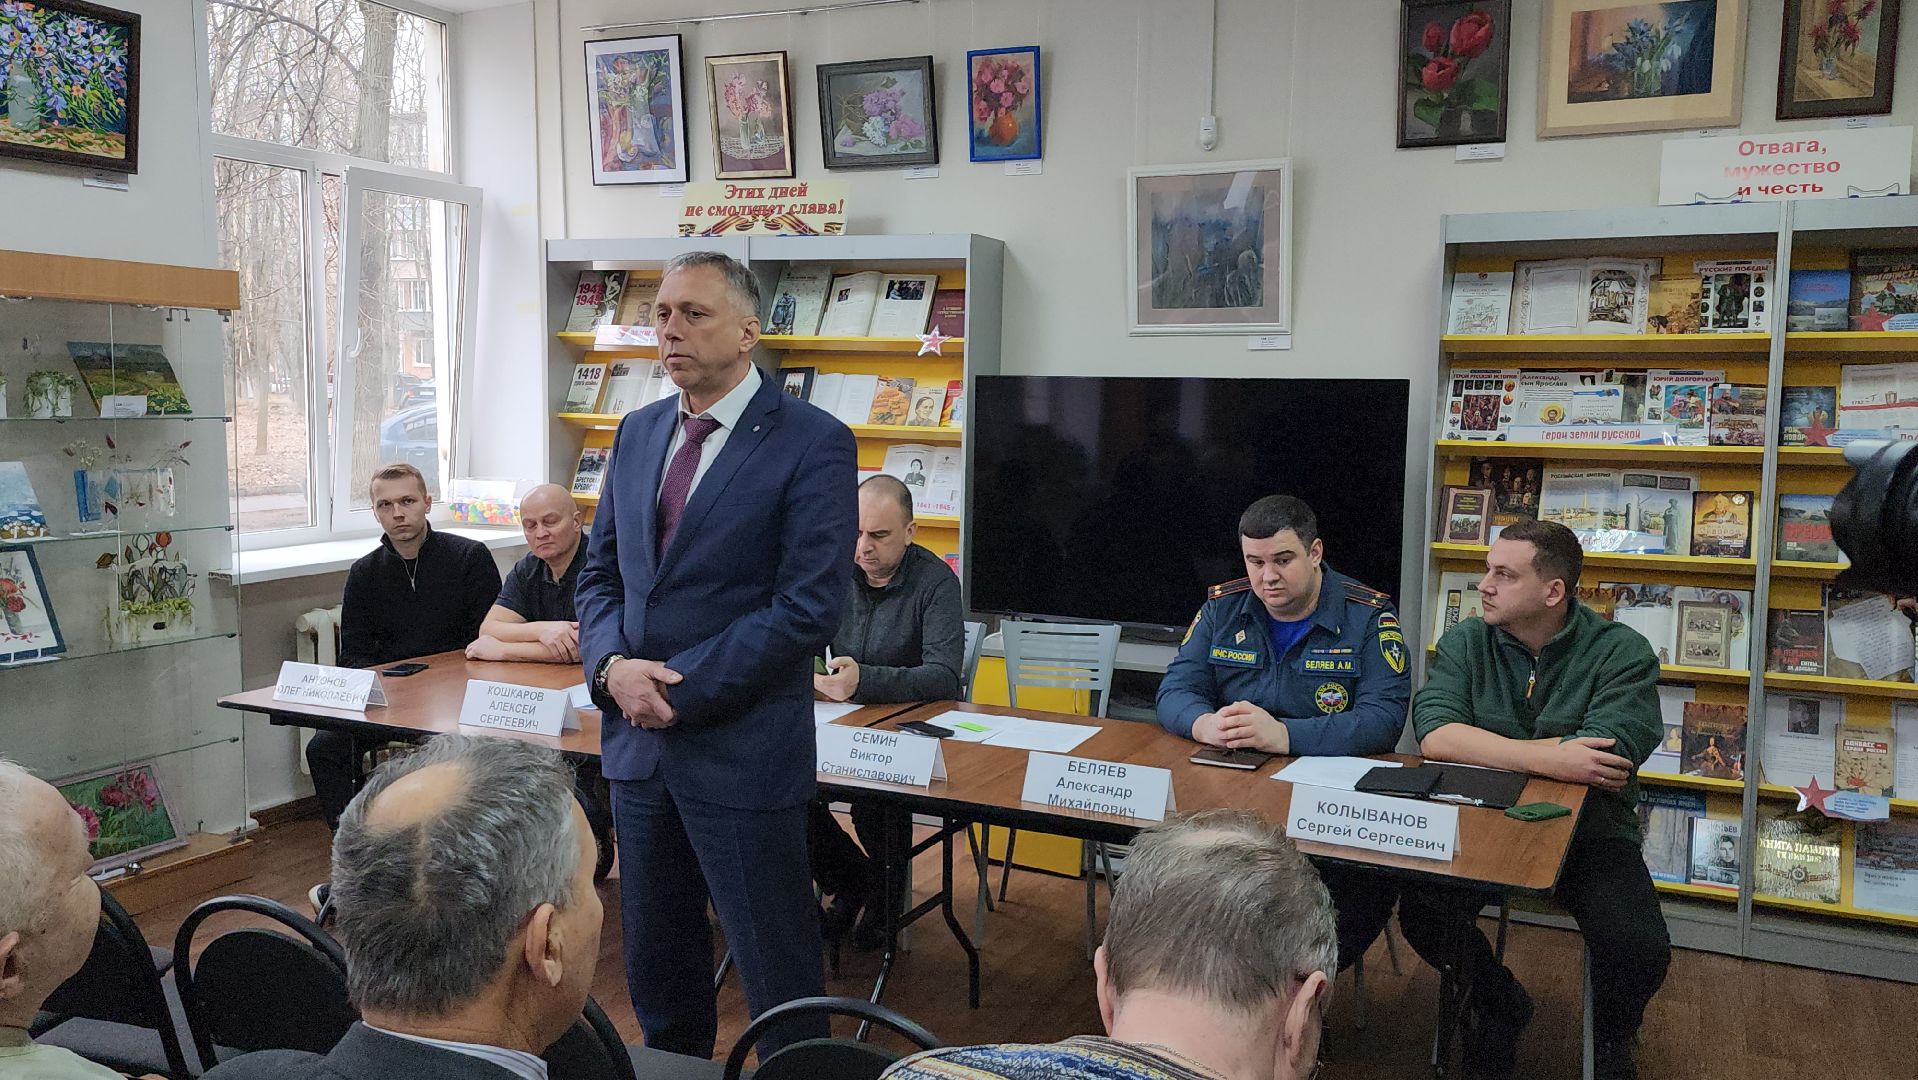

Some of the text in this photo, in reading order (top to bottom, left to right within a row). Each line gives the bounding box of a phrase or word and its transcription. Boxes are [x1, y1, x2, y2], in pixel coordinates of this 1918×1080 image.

[1738, 140, 1827, 156] Отвага,
[1724, 161, 1840, 180] мужество
[724, 182, 808, 201] Этих дней
[1738, 183, 1824, 196] и честь
[685, 199, 844, 218] не смолкнет слава!
[577, 367, 602, 380] 1418
[1541, 429, 1641, 441] Герои земли русской
[1228, 650, 1256, 662] РОССИИ
[1305, 660, 1334, 670] БЕЛЯЕВ
[278, 684, 302, 695] ОЛЕГ
[301, 674, 348, 688] АНТОНОВ
[487, 684, 545, 702] КОШКАРОВ
[488, 701, 537, 717] АЛЕКСЕЙ
[479, 713, 540, 730] СЕРГЕЕВИЧ
[852, 731, 899, 749] СЕМИН
[849, 748, 893, 766] Виктор
[820, 761, 917, 787] Станиславович
[1067, 760, 1127, 779] БЕЛЯЕВ
[1056, 776, 1134, 800] Александр
[1047, 793, 1138, 821] Михайлович
[1316, 800, 1428, 830] КОЛЫВАНОВ
[1296, 817, 1446, 853] Сергей Сергеевич
